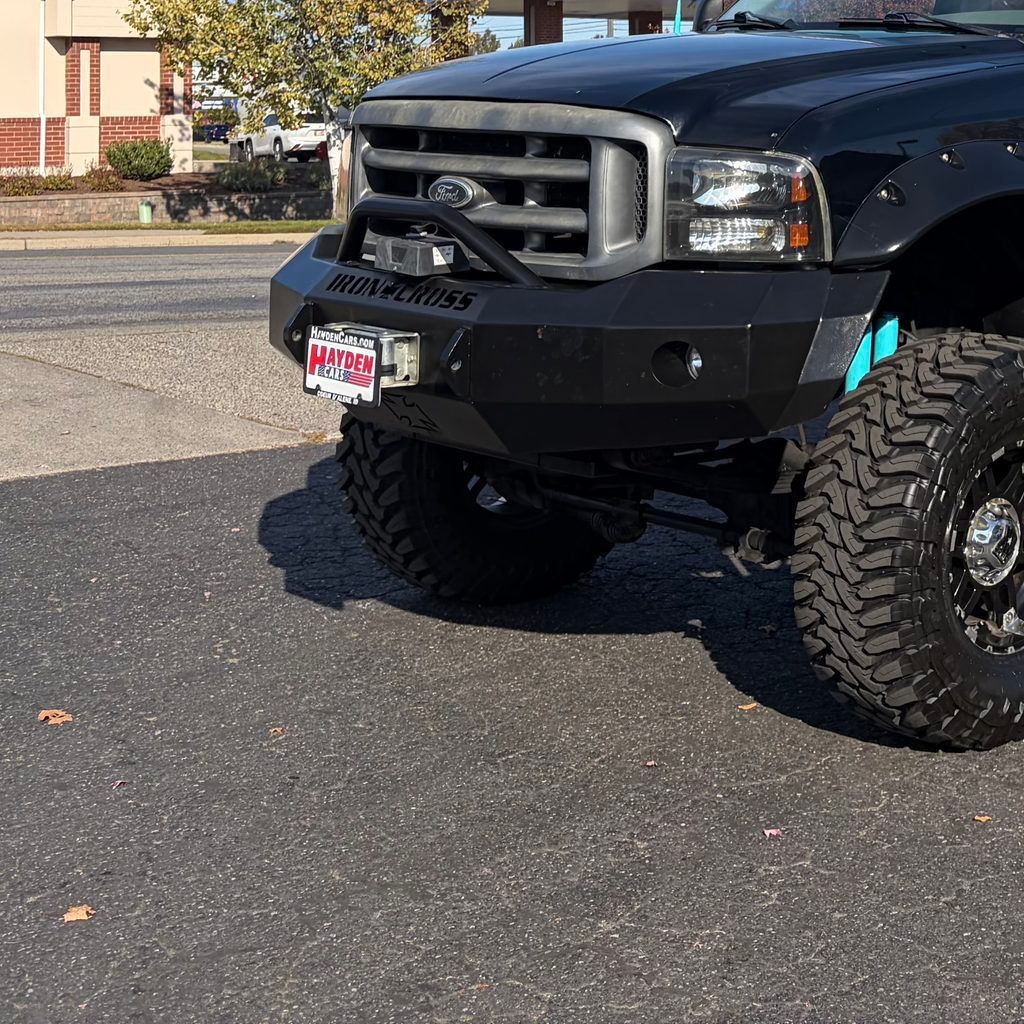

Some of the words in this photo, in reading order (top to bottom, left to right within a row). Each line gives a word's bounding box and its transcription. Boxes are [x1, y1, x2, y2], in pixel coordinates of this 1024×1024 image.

[435, 184, 459, 202] Ford
[325, 273, 387, 298] IRON
[393, 283, 478, 311] CROSS
[308, 344, 374, 375] HAYDEN
[324, 366, 344, 381] CARS
